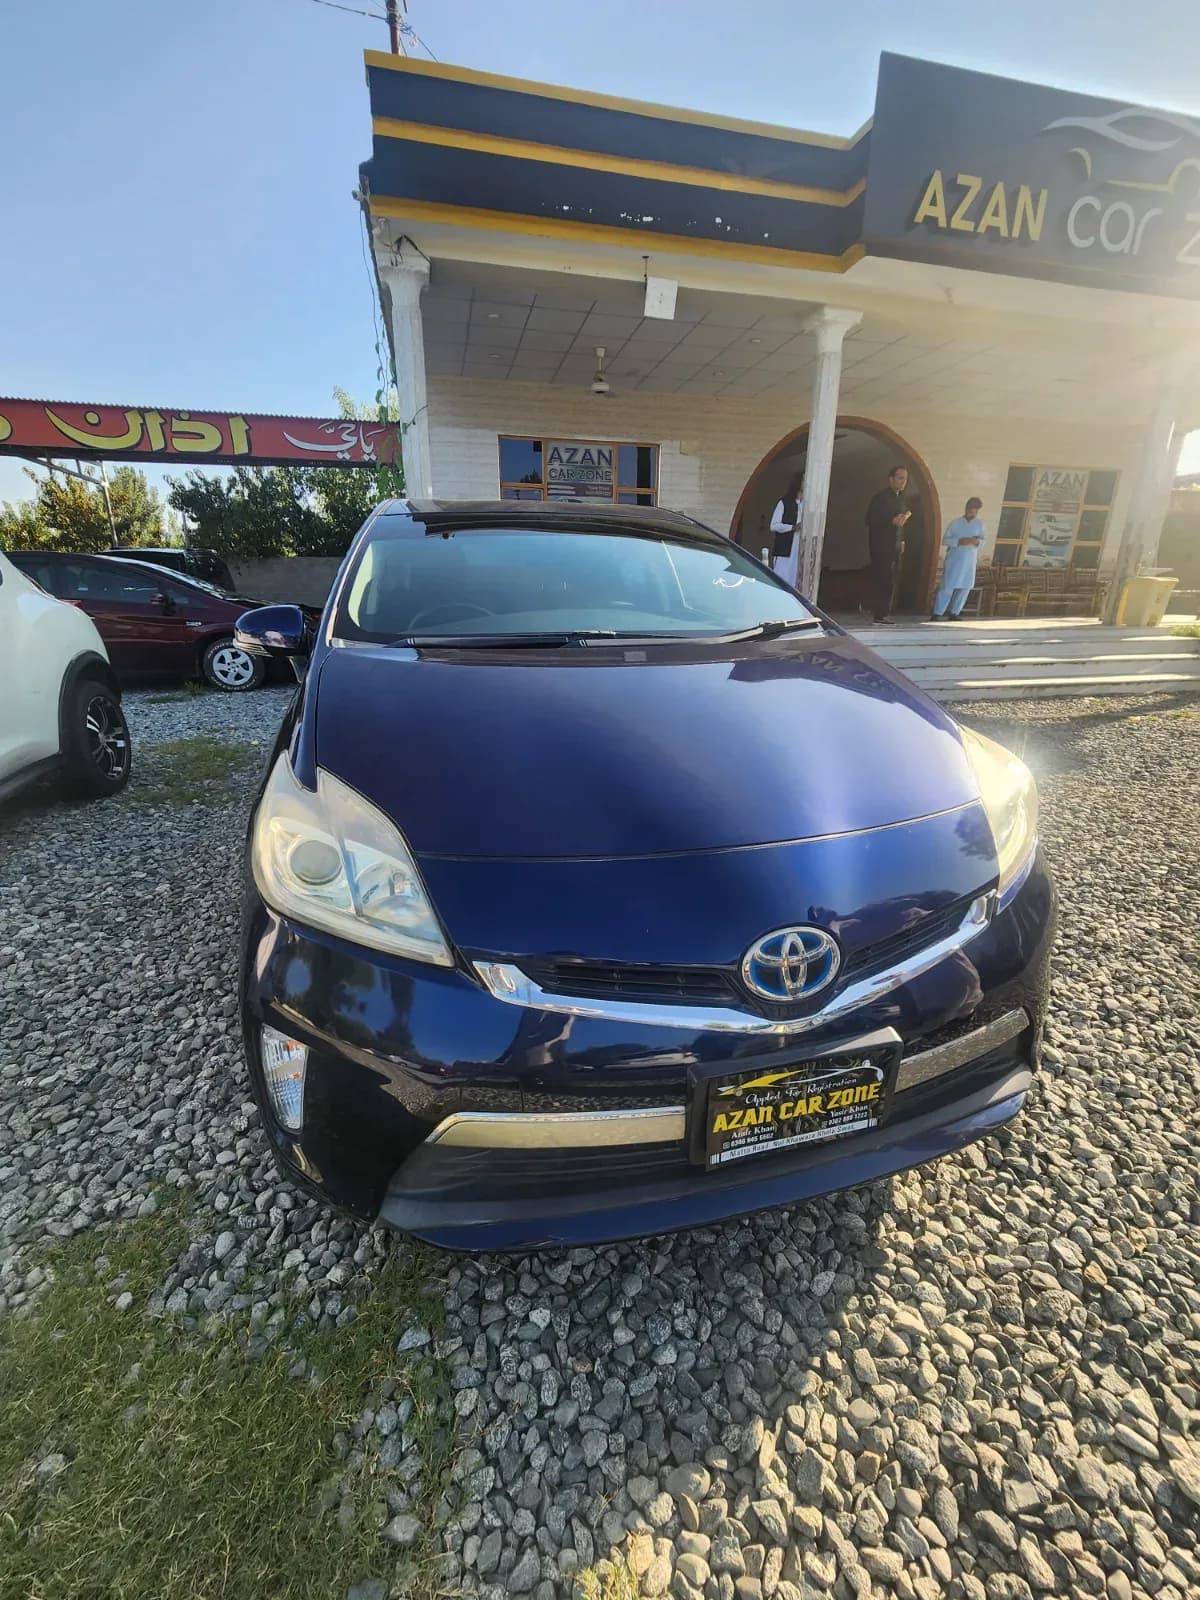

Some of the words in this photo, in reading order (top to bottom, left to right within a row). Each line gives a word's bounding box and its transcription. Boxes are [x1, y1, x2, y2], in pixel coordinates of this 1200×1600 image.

[913, 169, 1048, 241] AZAN
[1067, 196, 1163, 255] car
[548, 447, 612, 465] AZAN
[549, 468, 576, 481] CAR
[577, 469, 612, 481] ZONE
[1038, 471, 1085, 488] AZAN
[807, 1078, 857, 1094] Registration
[712, 1105, 773, 1133] AZAN
[779, 1095, 827, 1120] CAR
[826, 1082, 881, 1110] ZONE
[849, 1104, 868, 1114] Khan
[754, 1125, 774, 1135] Khan
